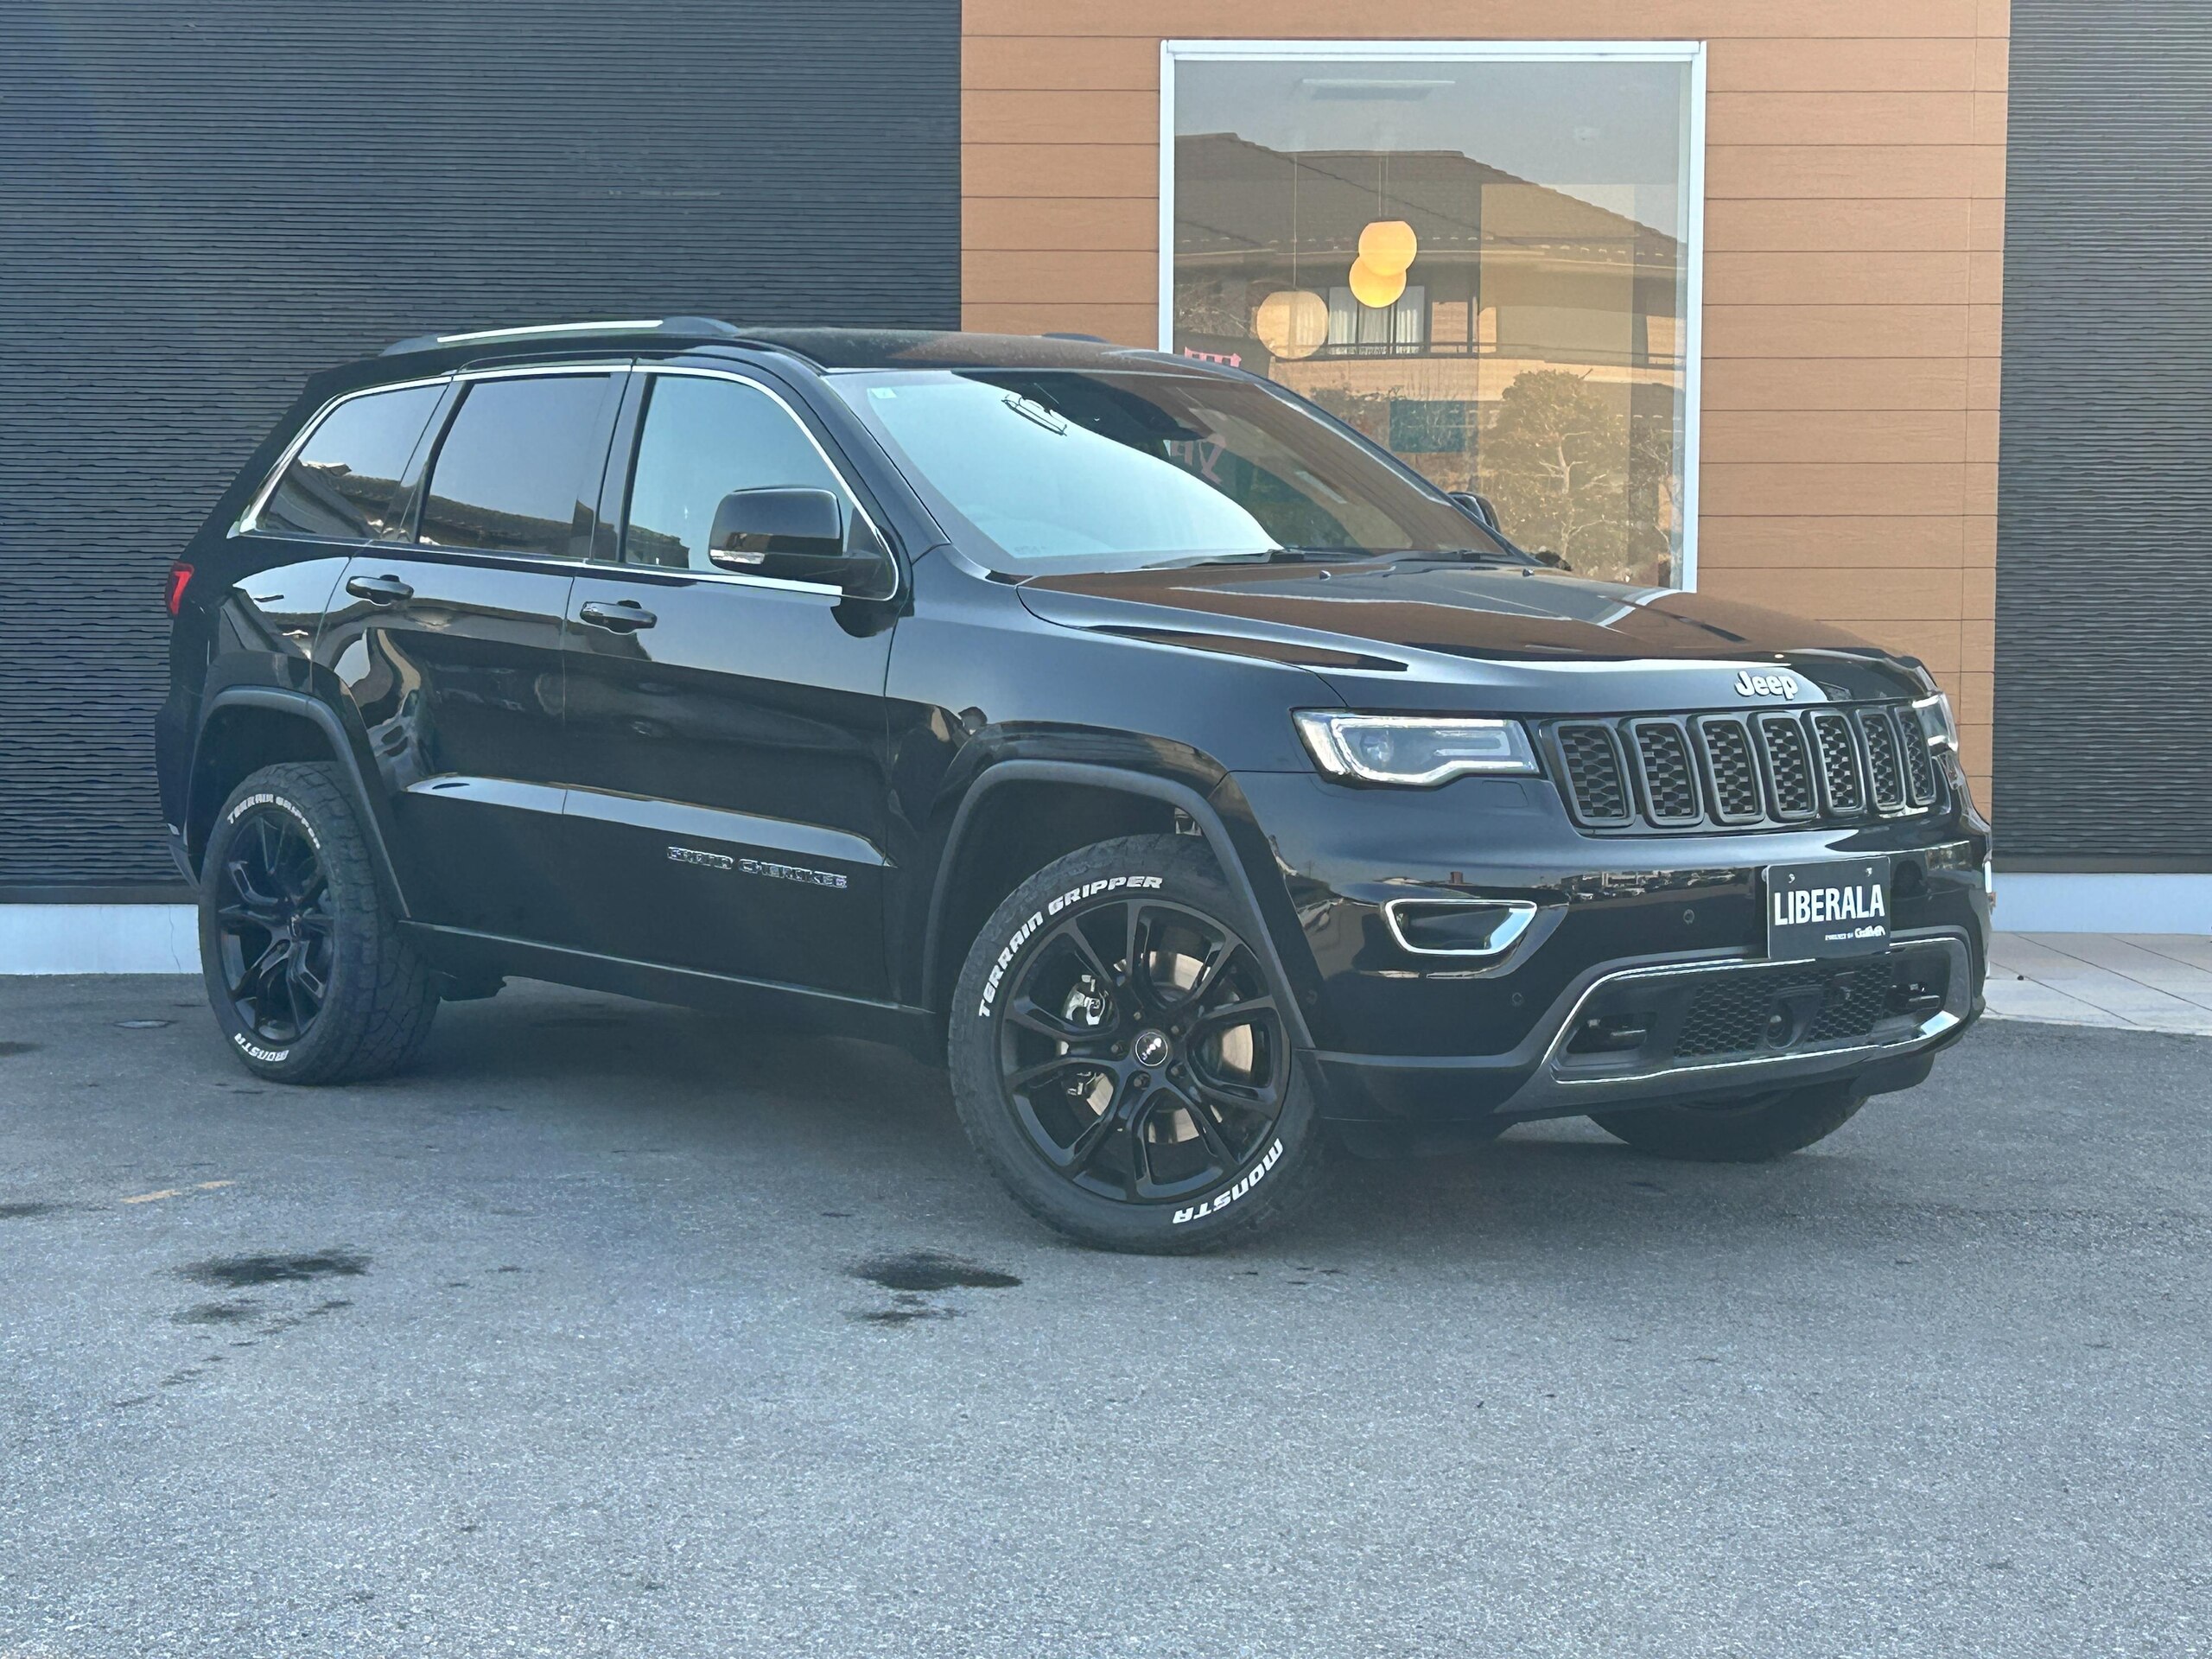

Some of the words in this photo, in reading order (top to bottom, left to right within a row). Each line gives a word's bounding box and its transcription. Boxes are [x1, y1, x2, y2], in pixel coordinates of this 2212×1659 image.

[1735, 671, 1799, 700] Jeep
[1774, 884, 1885, 925] LIBERALA
[978, 911, 1044, 1017] TERRAIN
[1047, 875, 1163, 916] GRIPPER
[1172, 1138, 1284, 1224] MONSTA
